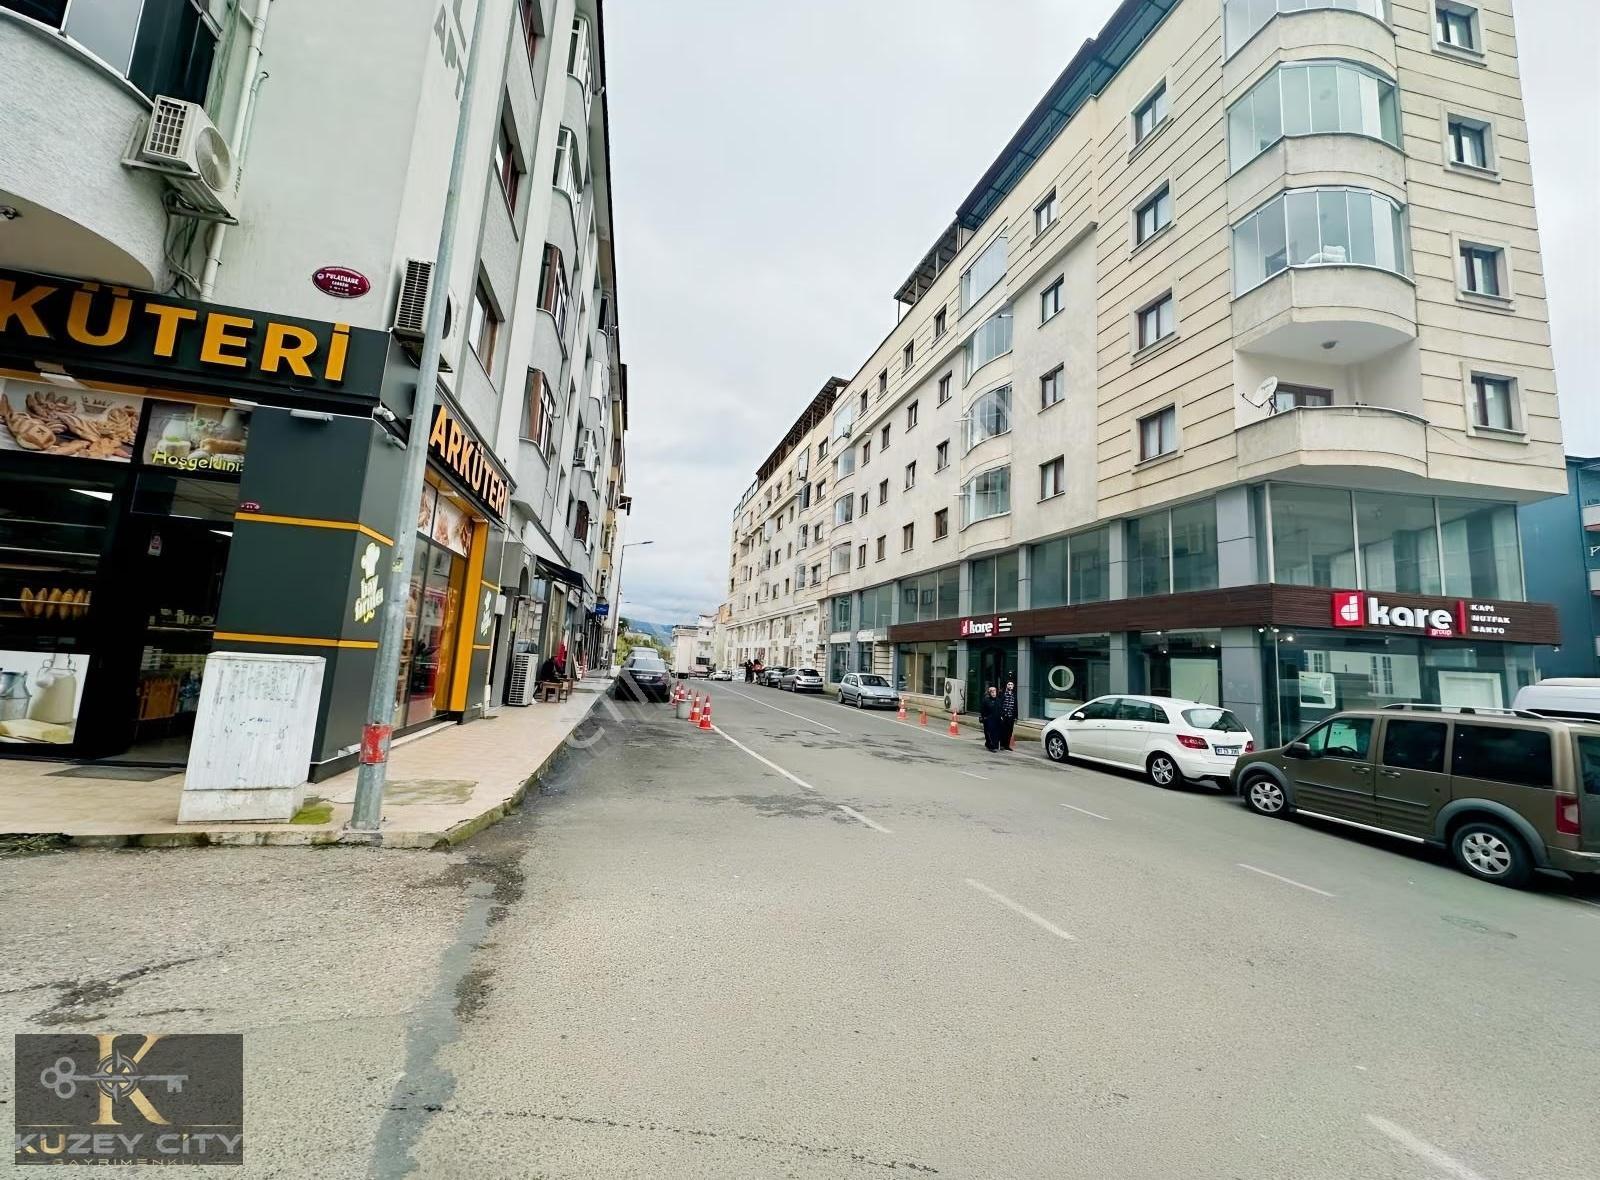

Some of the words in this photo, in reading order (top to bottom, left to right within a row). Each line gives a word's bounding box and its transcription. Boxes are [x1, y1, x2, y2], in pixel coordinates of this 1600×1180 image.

[1368, 597, 1452, 629] kare
[1471, 614, 1511, 623] MUTFAK
[970, 620, 993, 634] kare
[1471, 625, 1505, 634] BANYO
[1431, 628, 1452, 637] group
